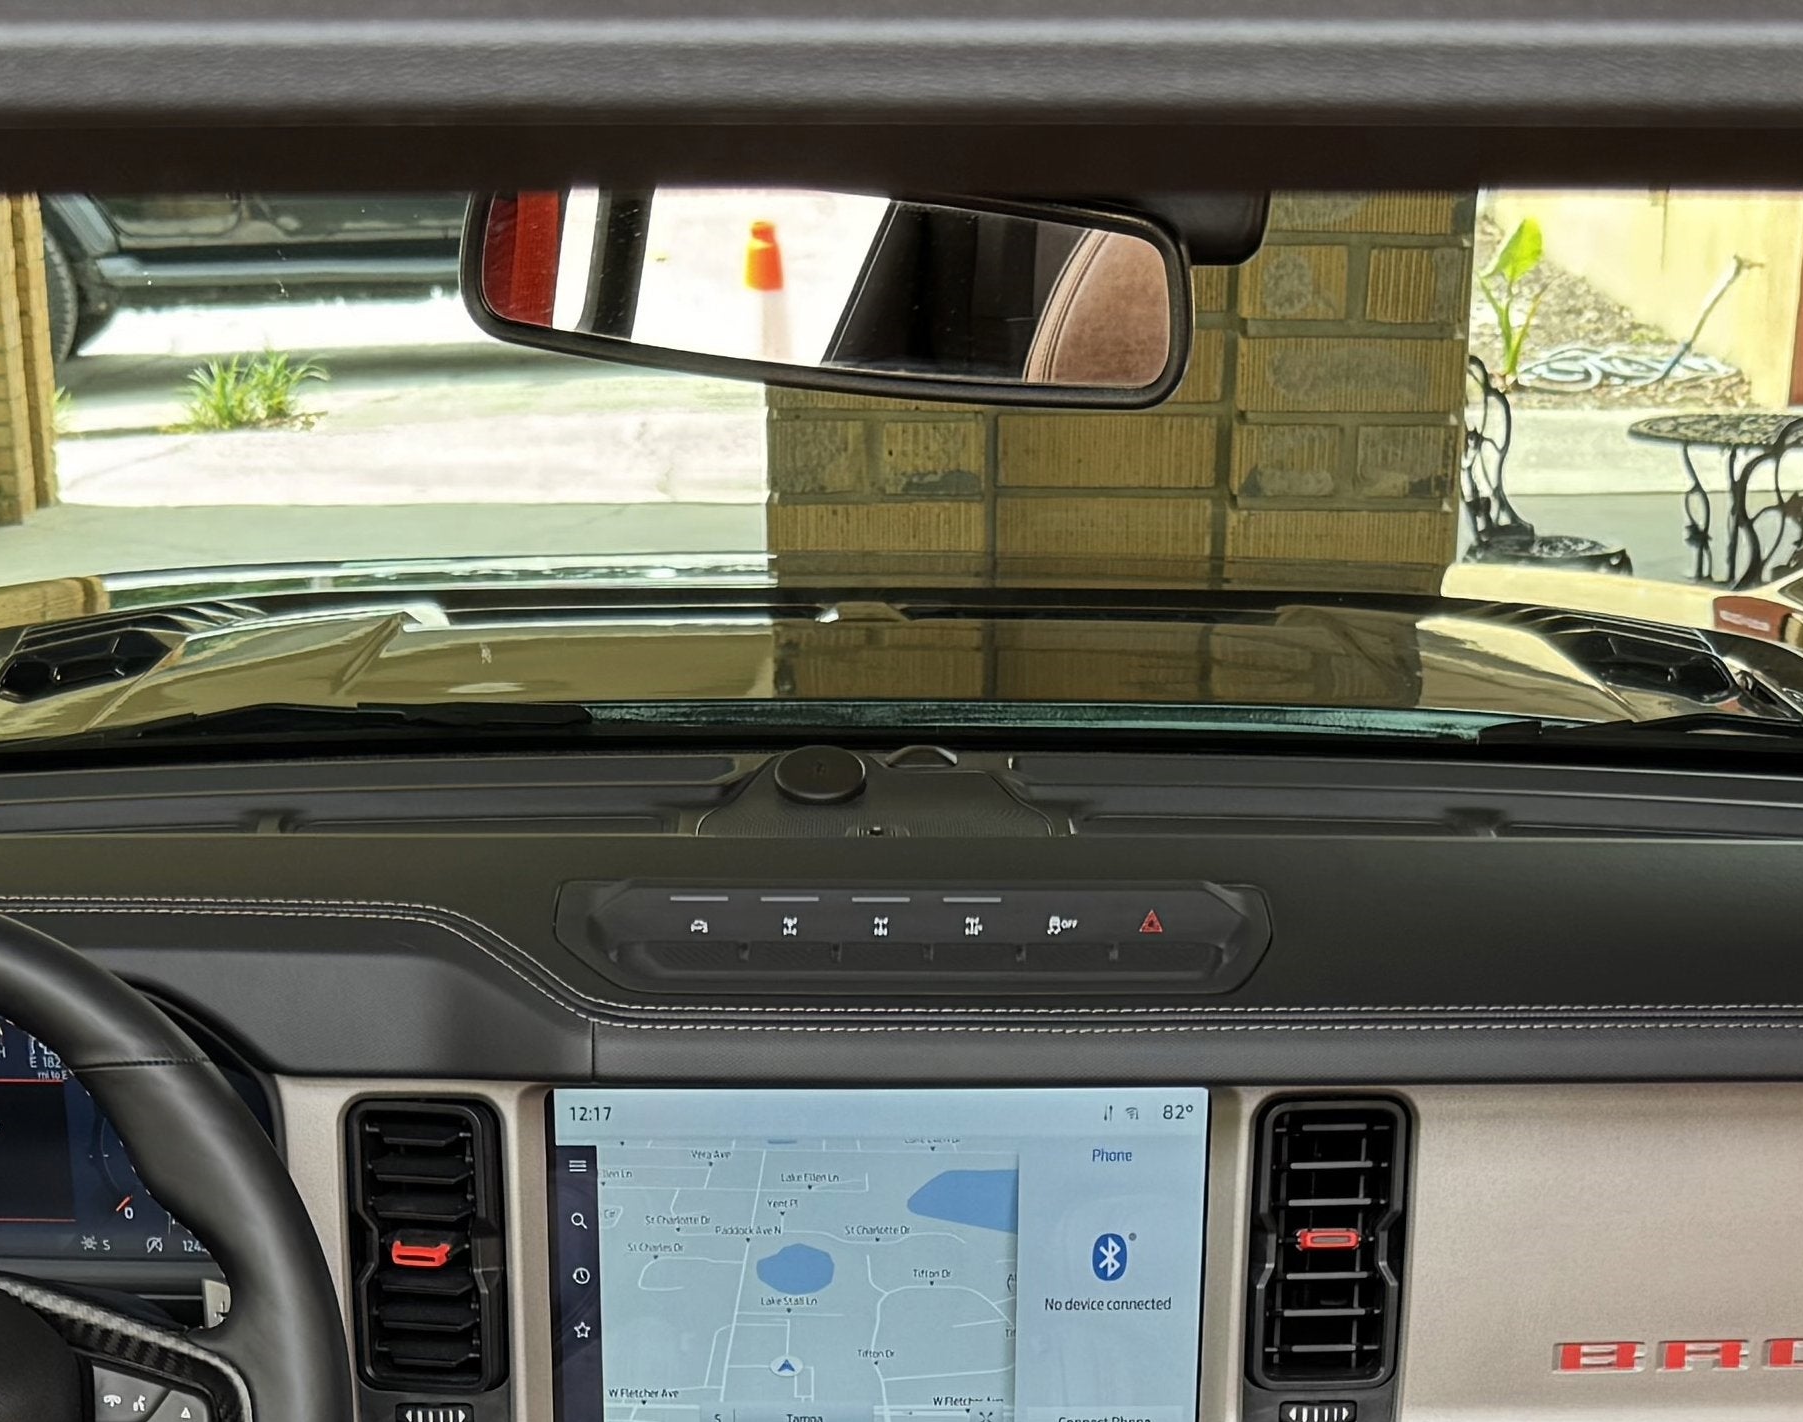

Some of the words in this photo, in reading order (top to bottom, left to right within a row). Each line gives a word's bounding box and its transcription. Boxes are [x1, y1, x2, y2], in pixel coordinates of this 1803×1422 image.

[1061, 919, 1078, 929] OFF
[29, 1056, 37, 1068] E
[42, 1056, 62, 1069] 182
[569, 1106, 612, 1122] 12:17
[1162, 1105, 1194, 1121] 82°
[1092, 1148, 1133, 1163] Phone
[715, 1225, 754, 1236] Paddock
[755, 1225, 773, 1236] Ave
[774, 1225, 782, 1235] N
[845, 1225, 855, 1235] St
[941, 1268, 951, 1278] Dr
[761, 1296, 781, 1306] Lake
[805, 1297, 818, 1307] Ln
[1044, 1298, 1063, 1311] No
[1065, 1297, 1104, 1311] device
[1106, 1297, 1172, 1312] connected
[885, 1349, 895, 1359] Dr
[608, 1388, 619, 1398] W
[620, 1388, 660, 1399] Fletcher
[661, 1389, 680, 1399] Ave
[933, 1396, 943, 1406] W
